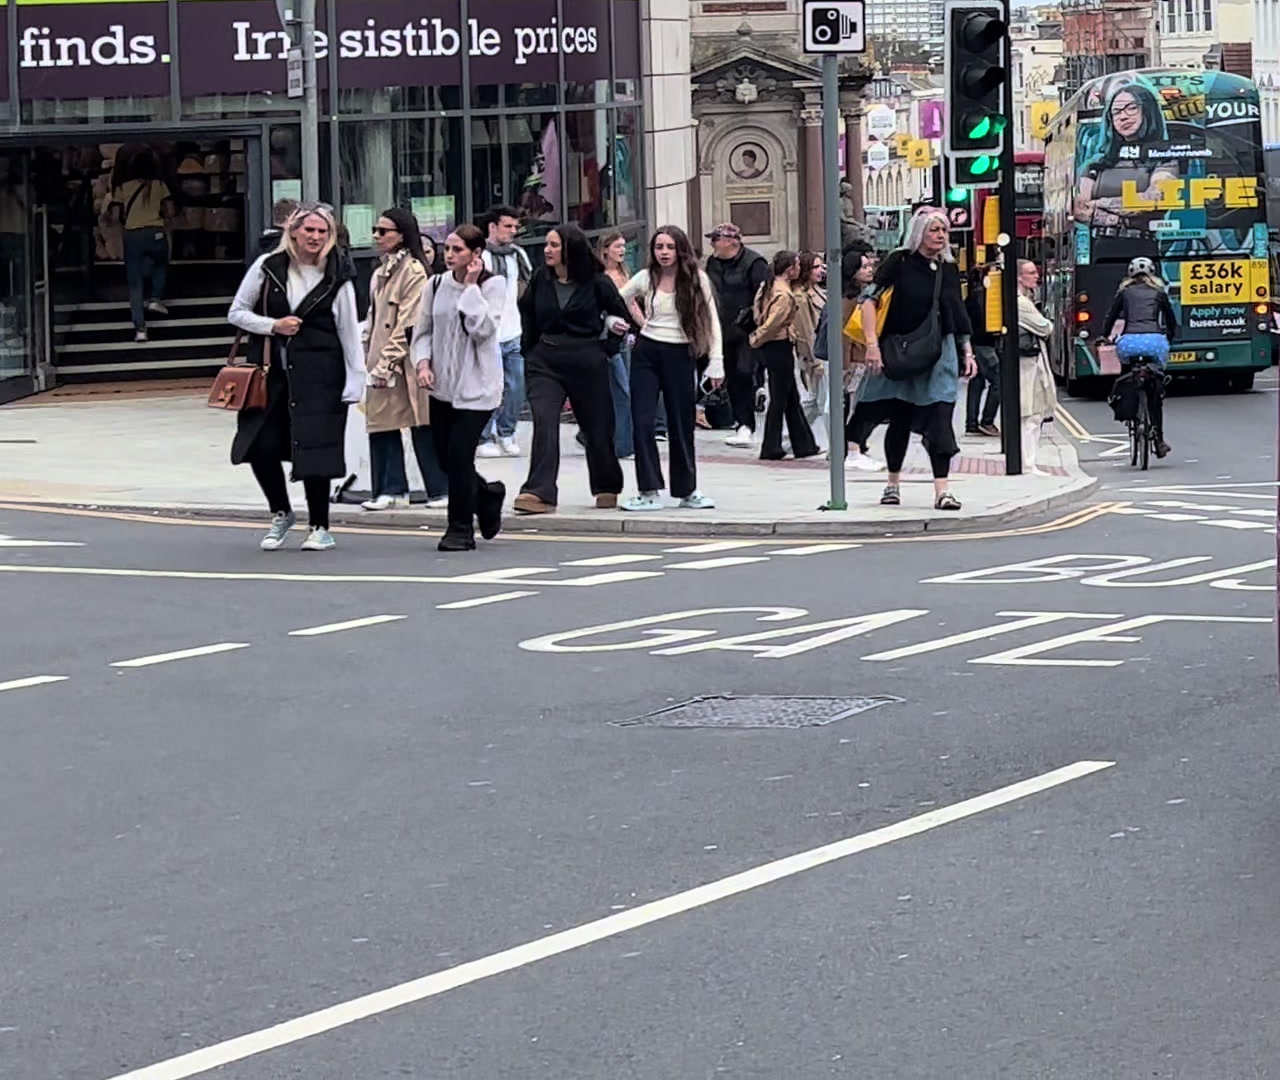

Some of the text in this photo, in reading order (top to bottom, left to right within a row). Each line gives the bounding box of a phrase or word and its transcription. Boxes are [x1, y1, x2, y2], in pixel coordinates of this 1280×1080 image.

[20, 25, 171, 67] finds.
[515, 17, 598, 65] prices
[1152, 75, 1204, 86] IT'S
[1205, 102, 1260, 119] YOUR
[1122, 177, 1259, 211] LIFE
[1190, 262, 1243, 279] £36k
[1190, 281, 1243, 296] salary
[1190, 306, 1220, 317] Apply
[1190, 317, 1246, 328] buses.co.uk
[517, 606, 1273, 668] GATE
